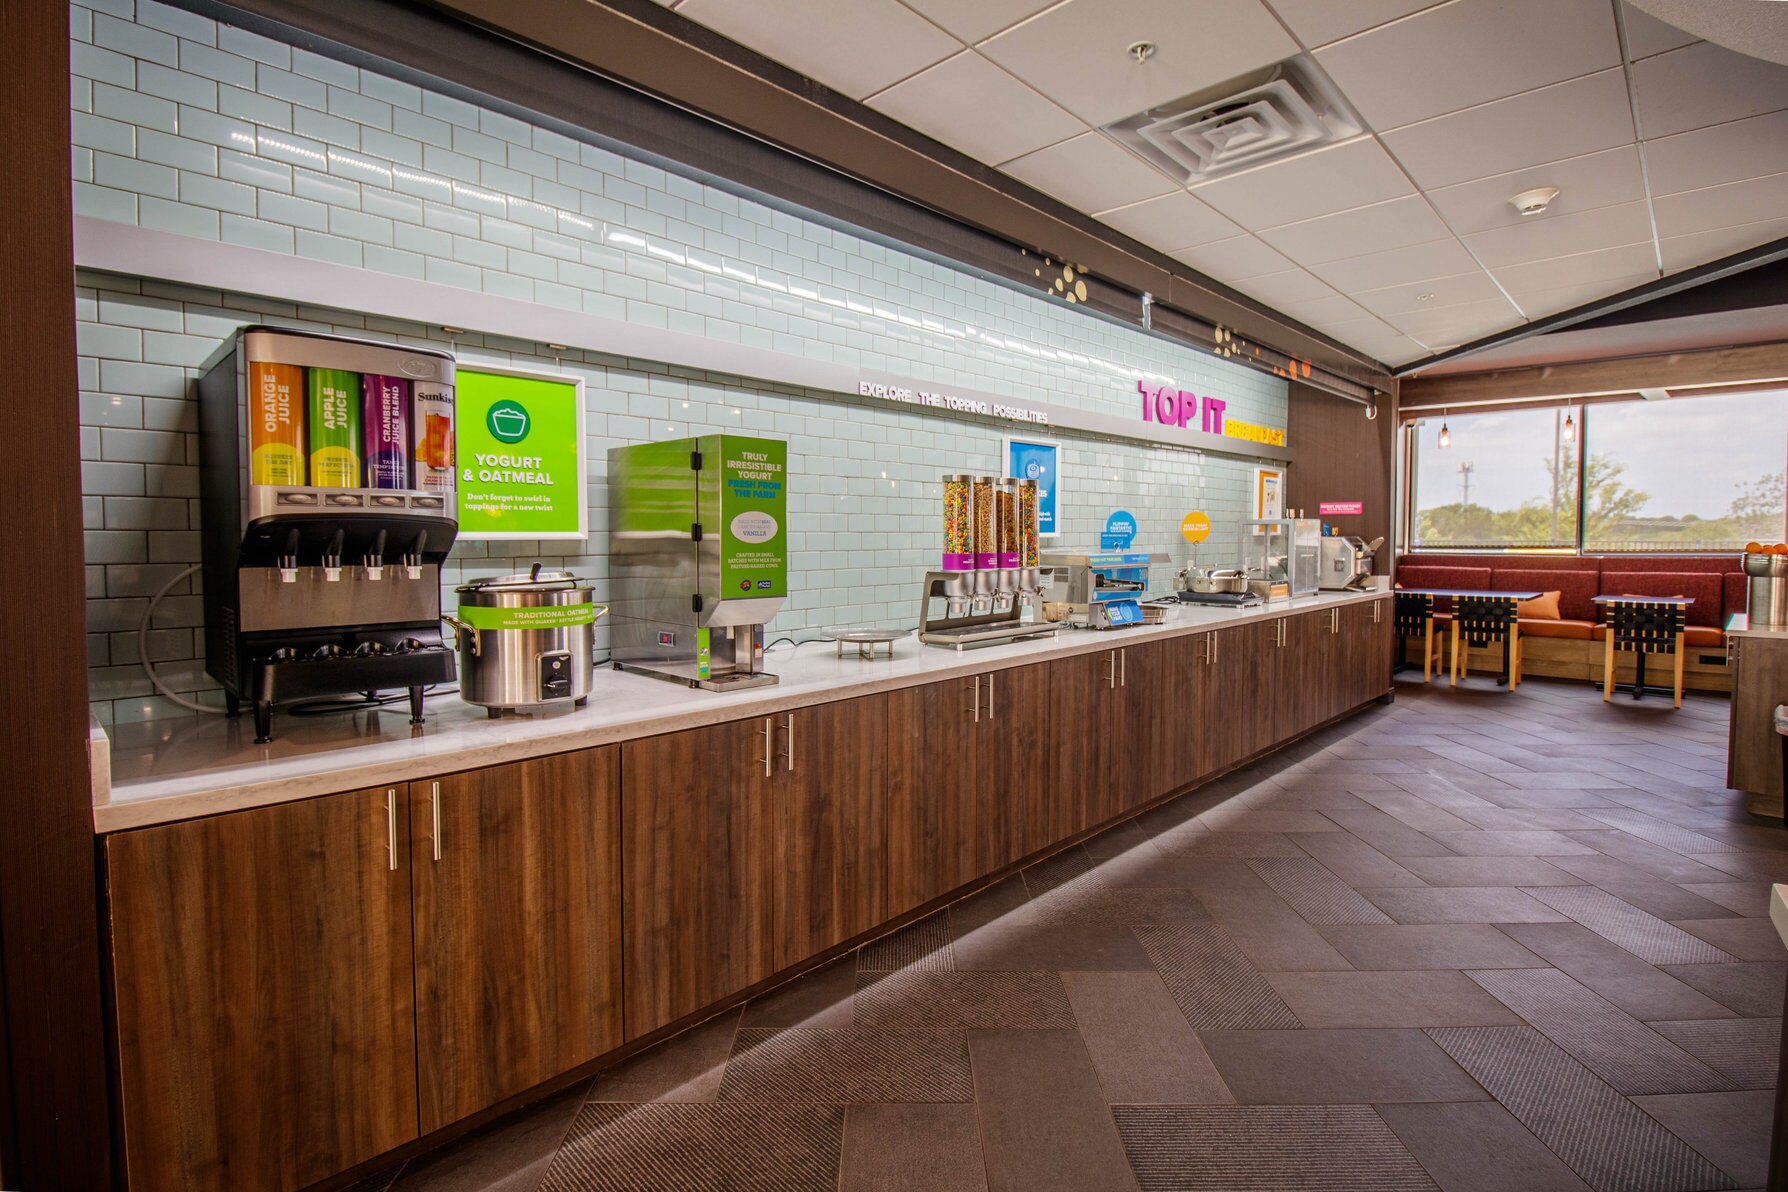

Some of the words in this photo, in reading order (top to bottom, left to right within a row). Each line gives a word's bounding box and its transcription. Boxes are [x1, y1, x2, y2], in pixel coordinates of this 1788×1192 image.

[264, 374, 277, 433] ORANGE
[278, 385, 290, 425] JUICE
[418, 392, 454, 404] Sunkis
[859, 381, 912, 402] EXPLORE
[918, 391, 940, 406] THE
[944, 395, 987, 415] TOPPING
[992, 404, 1048, 423] POSSIBILITIES
[323, 387, 335, 430] APPLE
[336, 390, 347, 429] JUICE
[383, 386, 391, 443] CRANBERRY
[1138, 380, 1197, 428] TOP
[1202, 397, 1226, 435] IT
[392, 415, 400, 445] JUICE
[475, 453, 542, 469] YOGURT
[742, 451, 768, 461] TRULY
[727, 460, 781, 472] IRRESISTIBLE
[463, 468, 473, 482] &
[478, 469, 554, 485] OATMEAL
[738, 470, 772, 480] YOGURT
[728, 479, 755, 488] FRESH
[757, 481, 781, 489] FROM
[490, 494, 513, 502] forget
[734, 489, 750, 497] THE
[753, 490, 776, 498] FARM
[465, 502, 499, 511] toppings
[513, 611, 566, 619] TRADITIONAL
